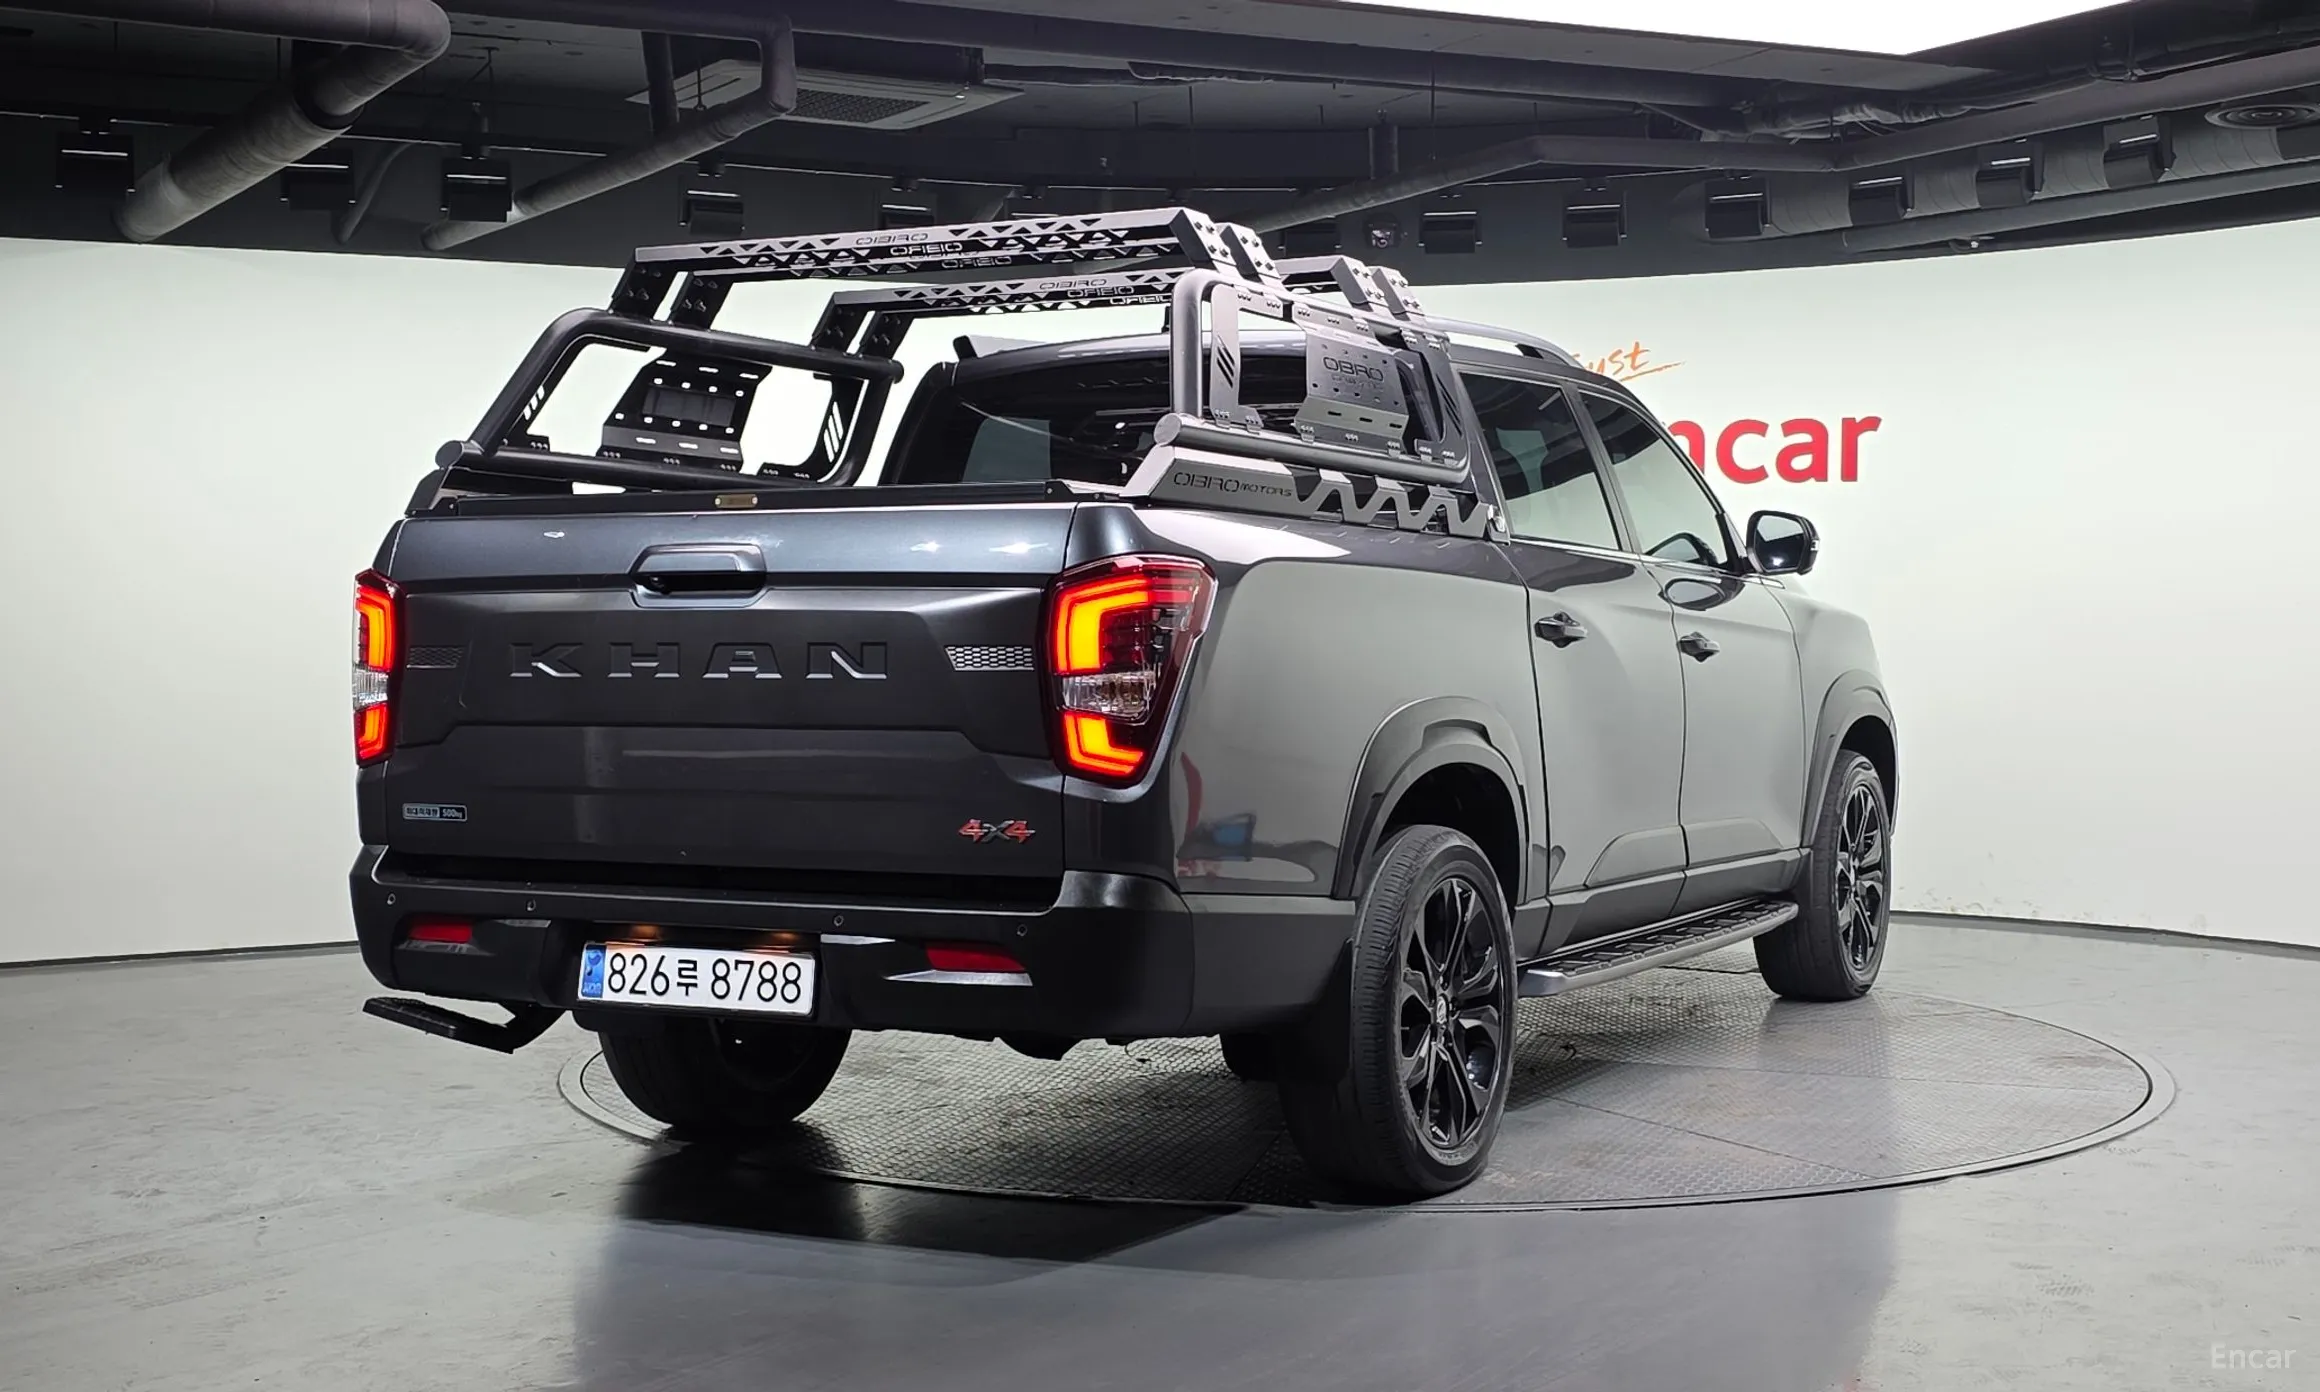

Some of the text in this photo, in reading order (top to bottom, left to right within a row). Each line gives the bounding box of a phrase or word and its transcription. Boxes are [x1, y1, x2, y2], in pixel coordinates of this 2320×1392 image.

[1323, 356, 1384, 382] OBRO
[1573, 341, 1651, 376] ust
[1667, 416, 1882, 484] ncar
[1173, 472, 1240, 493] OBRO
[509, 642, 888, 680] KHAN
[608, 952, 802, 1004] 826루 8788
